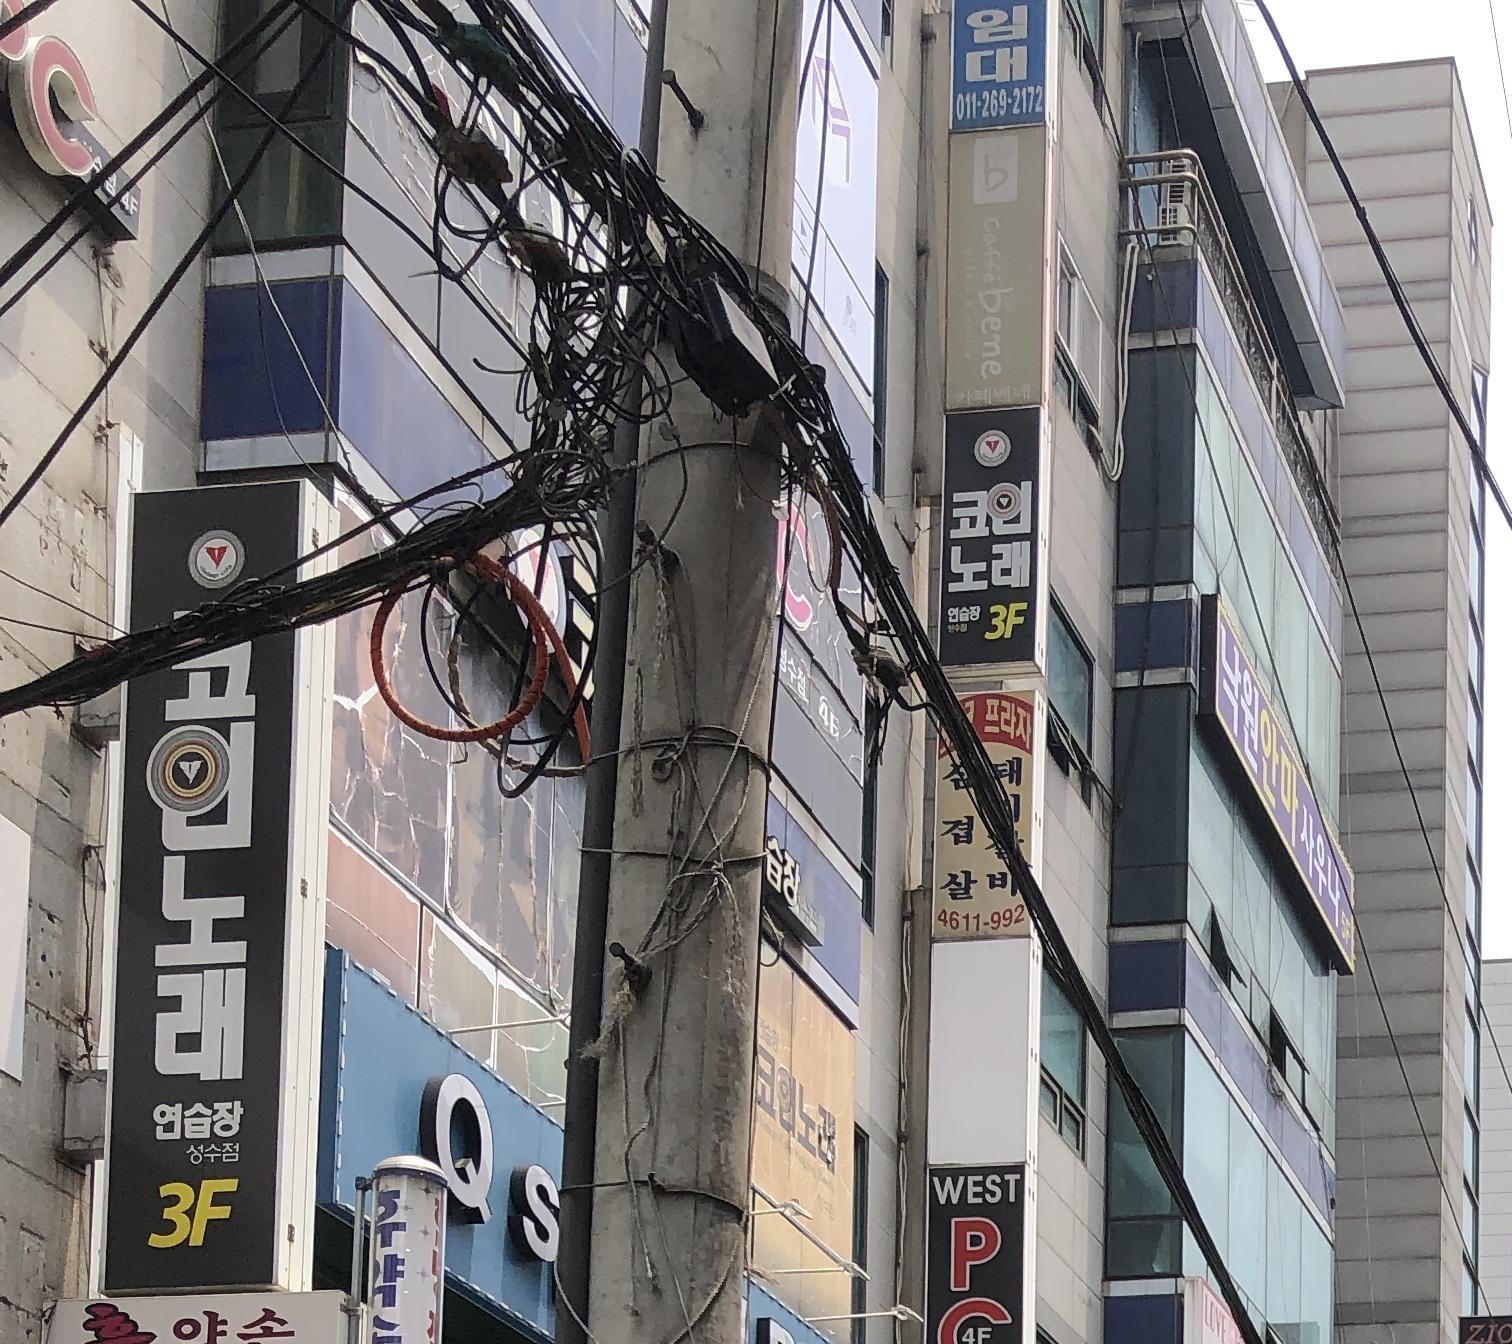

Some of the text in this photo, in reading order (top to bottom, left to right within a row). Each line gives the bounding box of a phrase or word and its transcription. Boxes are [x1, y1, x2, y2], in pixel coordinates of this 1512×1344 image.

[966, 5, 1028, 83] 임대
[956, 85, 1044, 120] 011-269-2172
[950, 481, 1033, 540] 코인
[948, 541, 1031, 592] 노래
[947, 606, 981, 623] 연습장
[984, 602, 1028, 640] 3F
[1301, 805, 1340, 928] 사우나
[938, 903, 1025, 932] 4611-992
[153, 1101, 243, 1141] 연습장
[185, 1143, 240, 1165] 성수점
[436, 1073, 493, 1225] Q
[933, 1174, 1020, 1205] WEST
[148, 1179, 238, 1248] 3F
